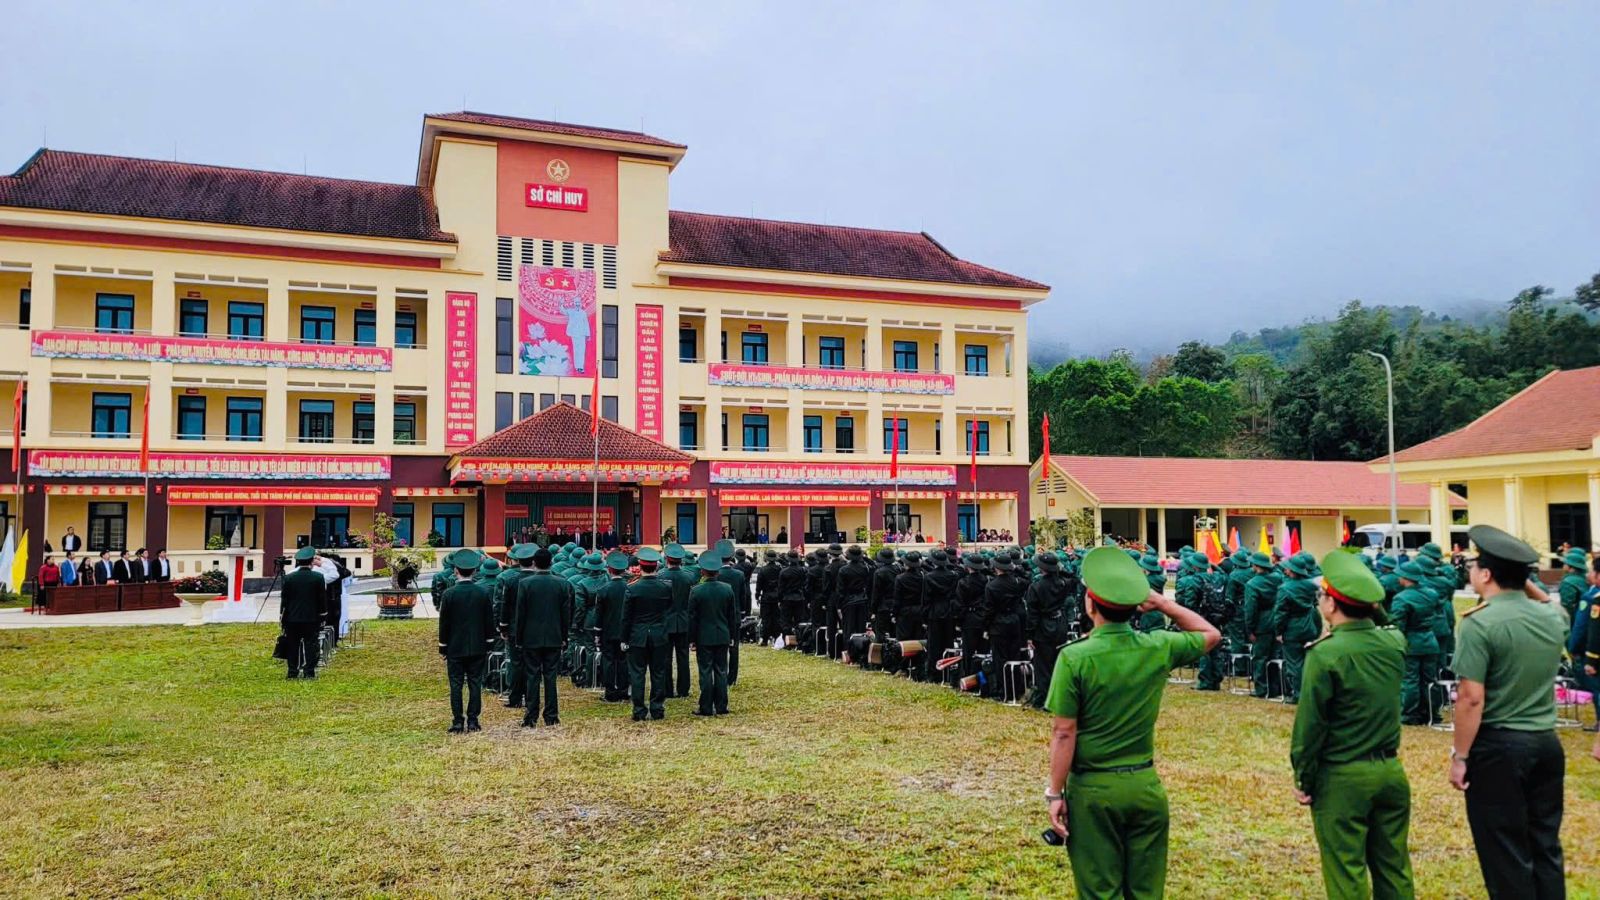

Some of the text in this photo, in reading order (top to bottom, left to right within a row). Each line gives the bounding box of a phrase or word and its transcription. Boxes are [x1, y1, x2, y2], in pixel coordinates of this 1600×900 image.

[530, 185, 582, 206] SỞ CHỈ HUY
